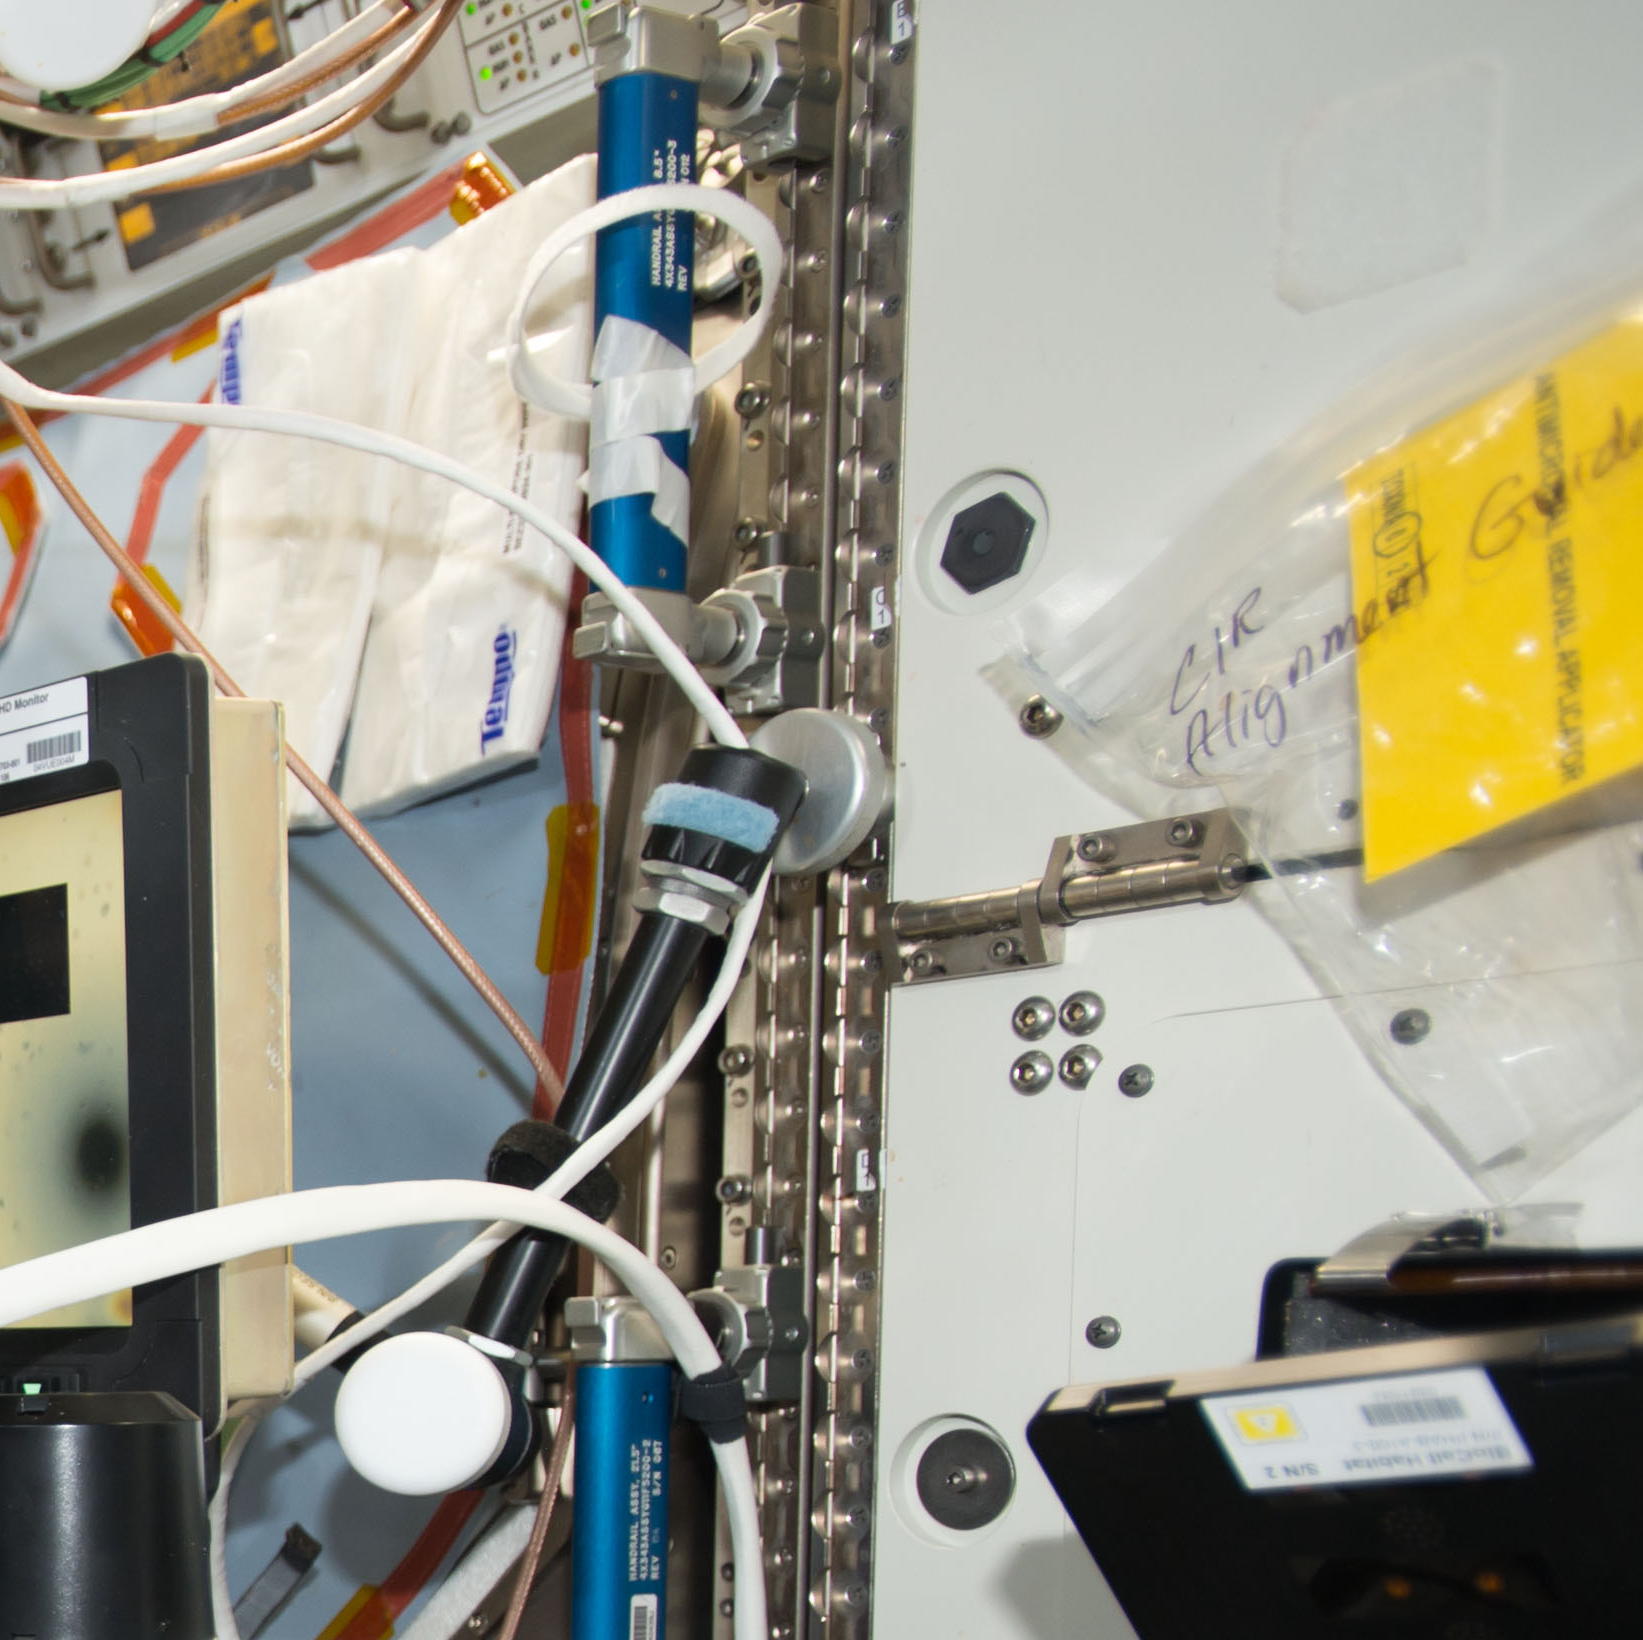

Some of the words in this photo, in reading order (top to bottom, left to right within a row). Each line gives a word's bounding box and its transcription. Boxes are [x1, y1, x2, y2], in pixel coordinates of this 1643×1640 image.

[652, 225, 663, 287] HANDRAIL
[677, 264, 689, 292] REV
[1547, 538, 1578, 645] REMOVAL
[0, 701, 12, 715] HD
[14, 692, 50, 710] Monitor
[1556, 649, 1586, 786] APPLICATOR
[630, 1479, 640, 1516] ASSY,
[652, 1470, 662, 1497] S/N
[628, 1521, 639, 1582] HANDRAIL
[650, 1555, 660, 1581] REV
